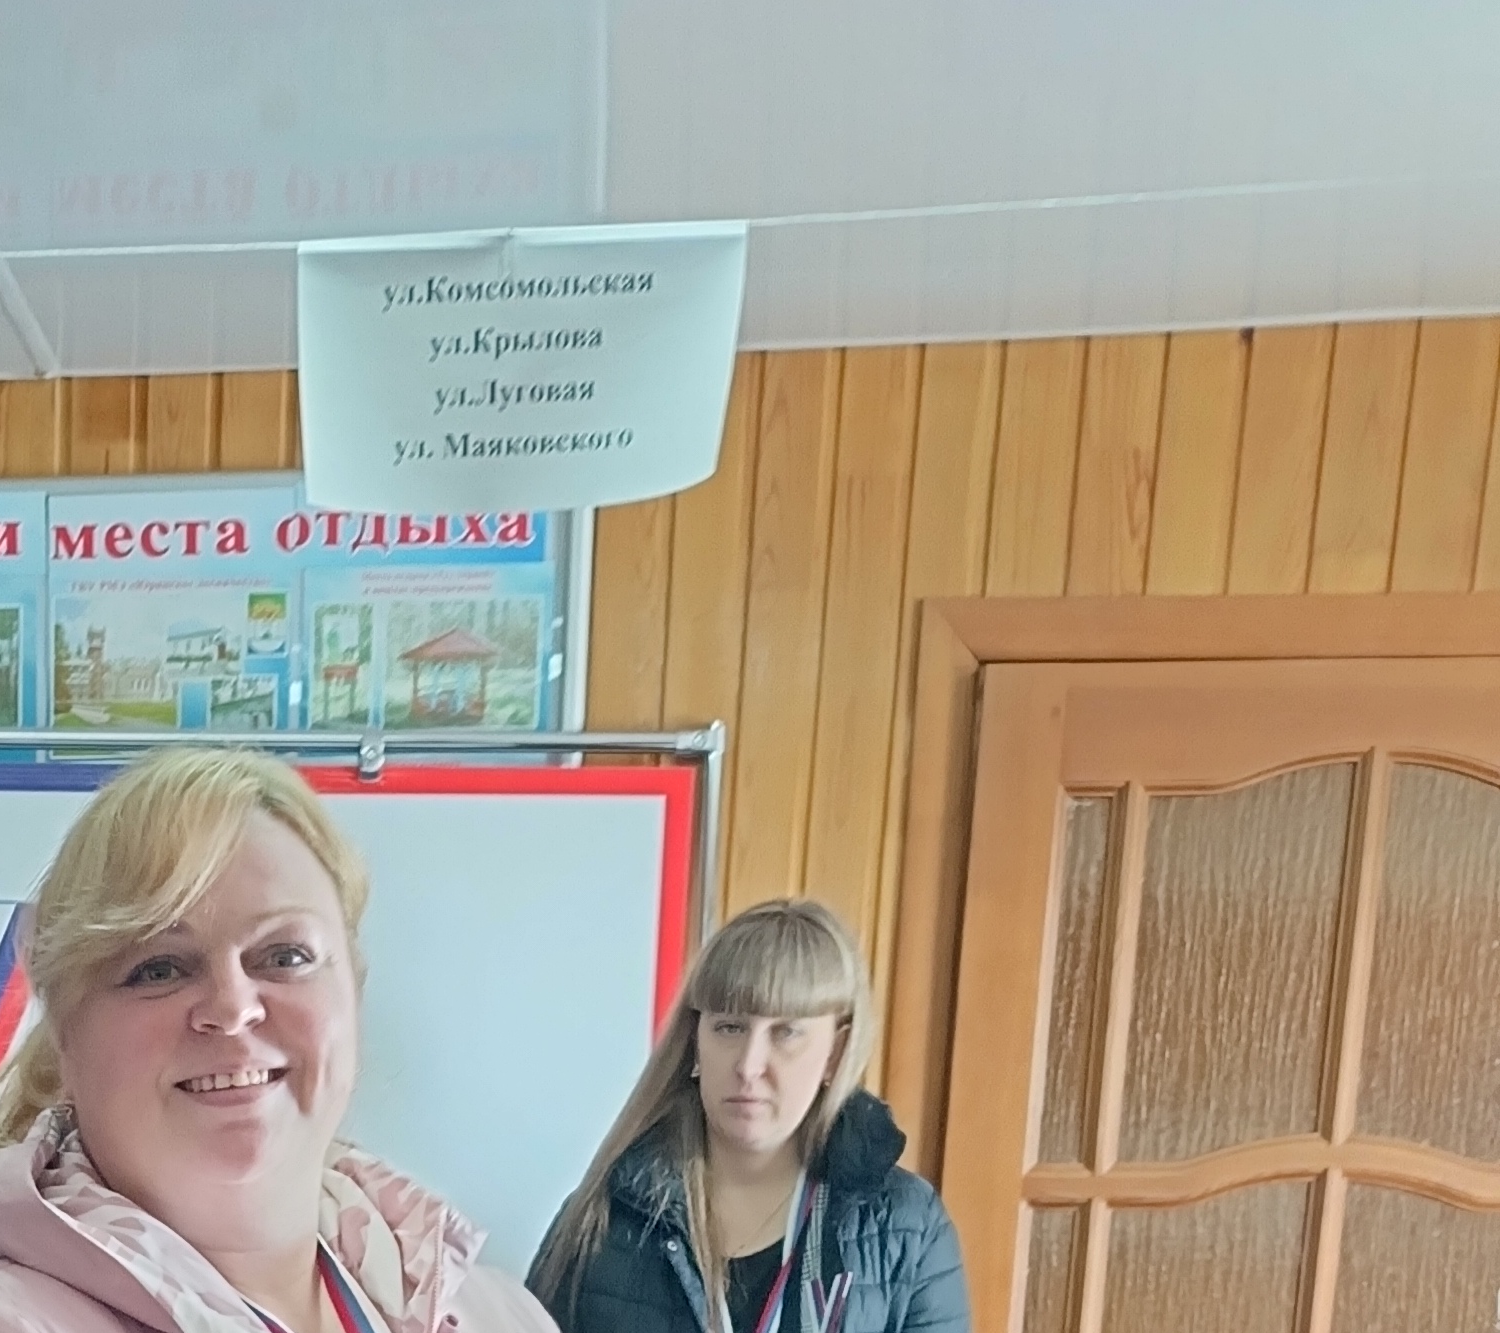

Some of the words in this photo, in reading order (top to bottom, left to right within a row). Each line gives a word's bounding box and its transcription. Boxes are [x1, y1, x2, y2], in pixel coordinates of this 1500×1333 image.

[381, 270, 656, 312] ул.Комсомольская
[428, 326, 603, 362] ул.Крылова
[434, 379, 595, 415] ул.Луговая
[393, 437, 434, 466] ул.
[443, 427, 634, 460] Маяковского
[52, 516, 251, 561] места
[276, 511, 534, 553] отдыха
